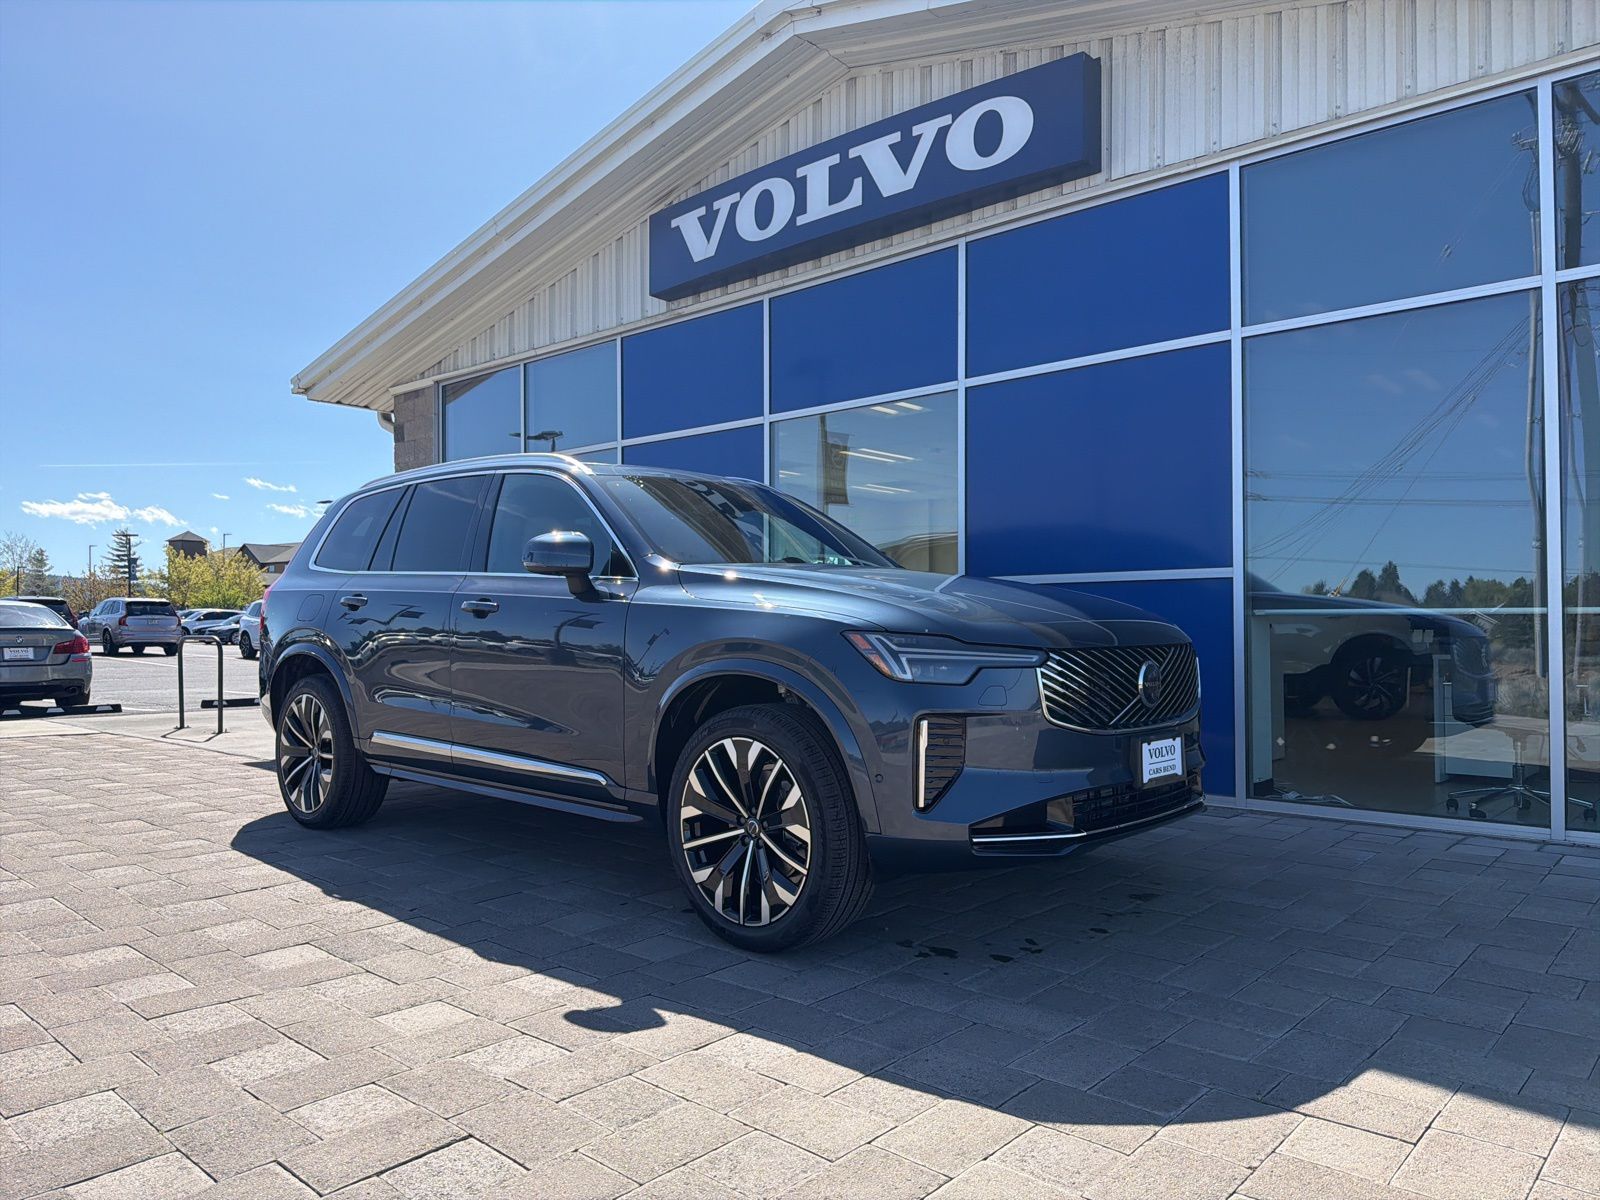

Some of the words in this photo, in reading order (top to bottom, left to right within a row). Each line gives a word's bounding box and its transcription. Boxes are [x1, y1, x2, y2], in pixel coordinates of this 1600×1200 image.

[671, 95, 1035, 263] VOLVO
[1148, 744, 1176, 759] VOLVO
[1148, 766, 1162, 775] CARS
